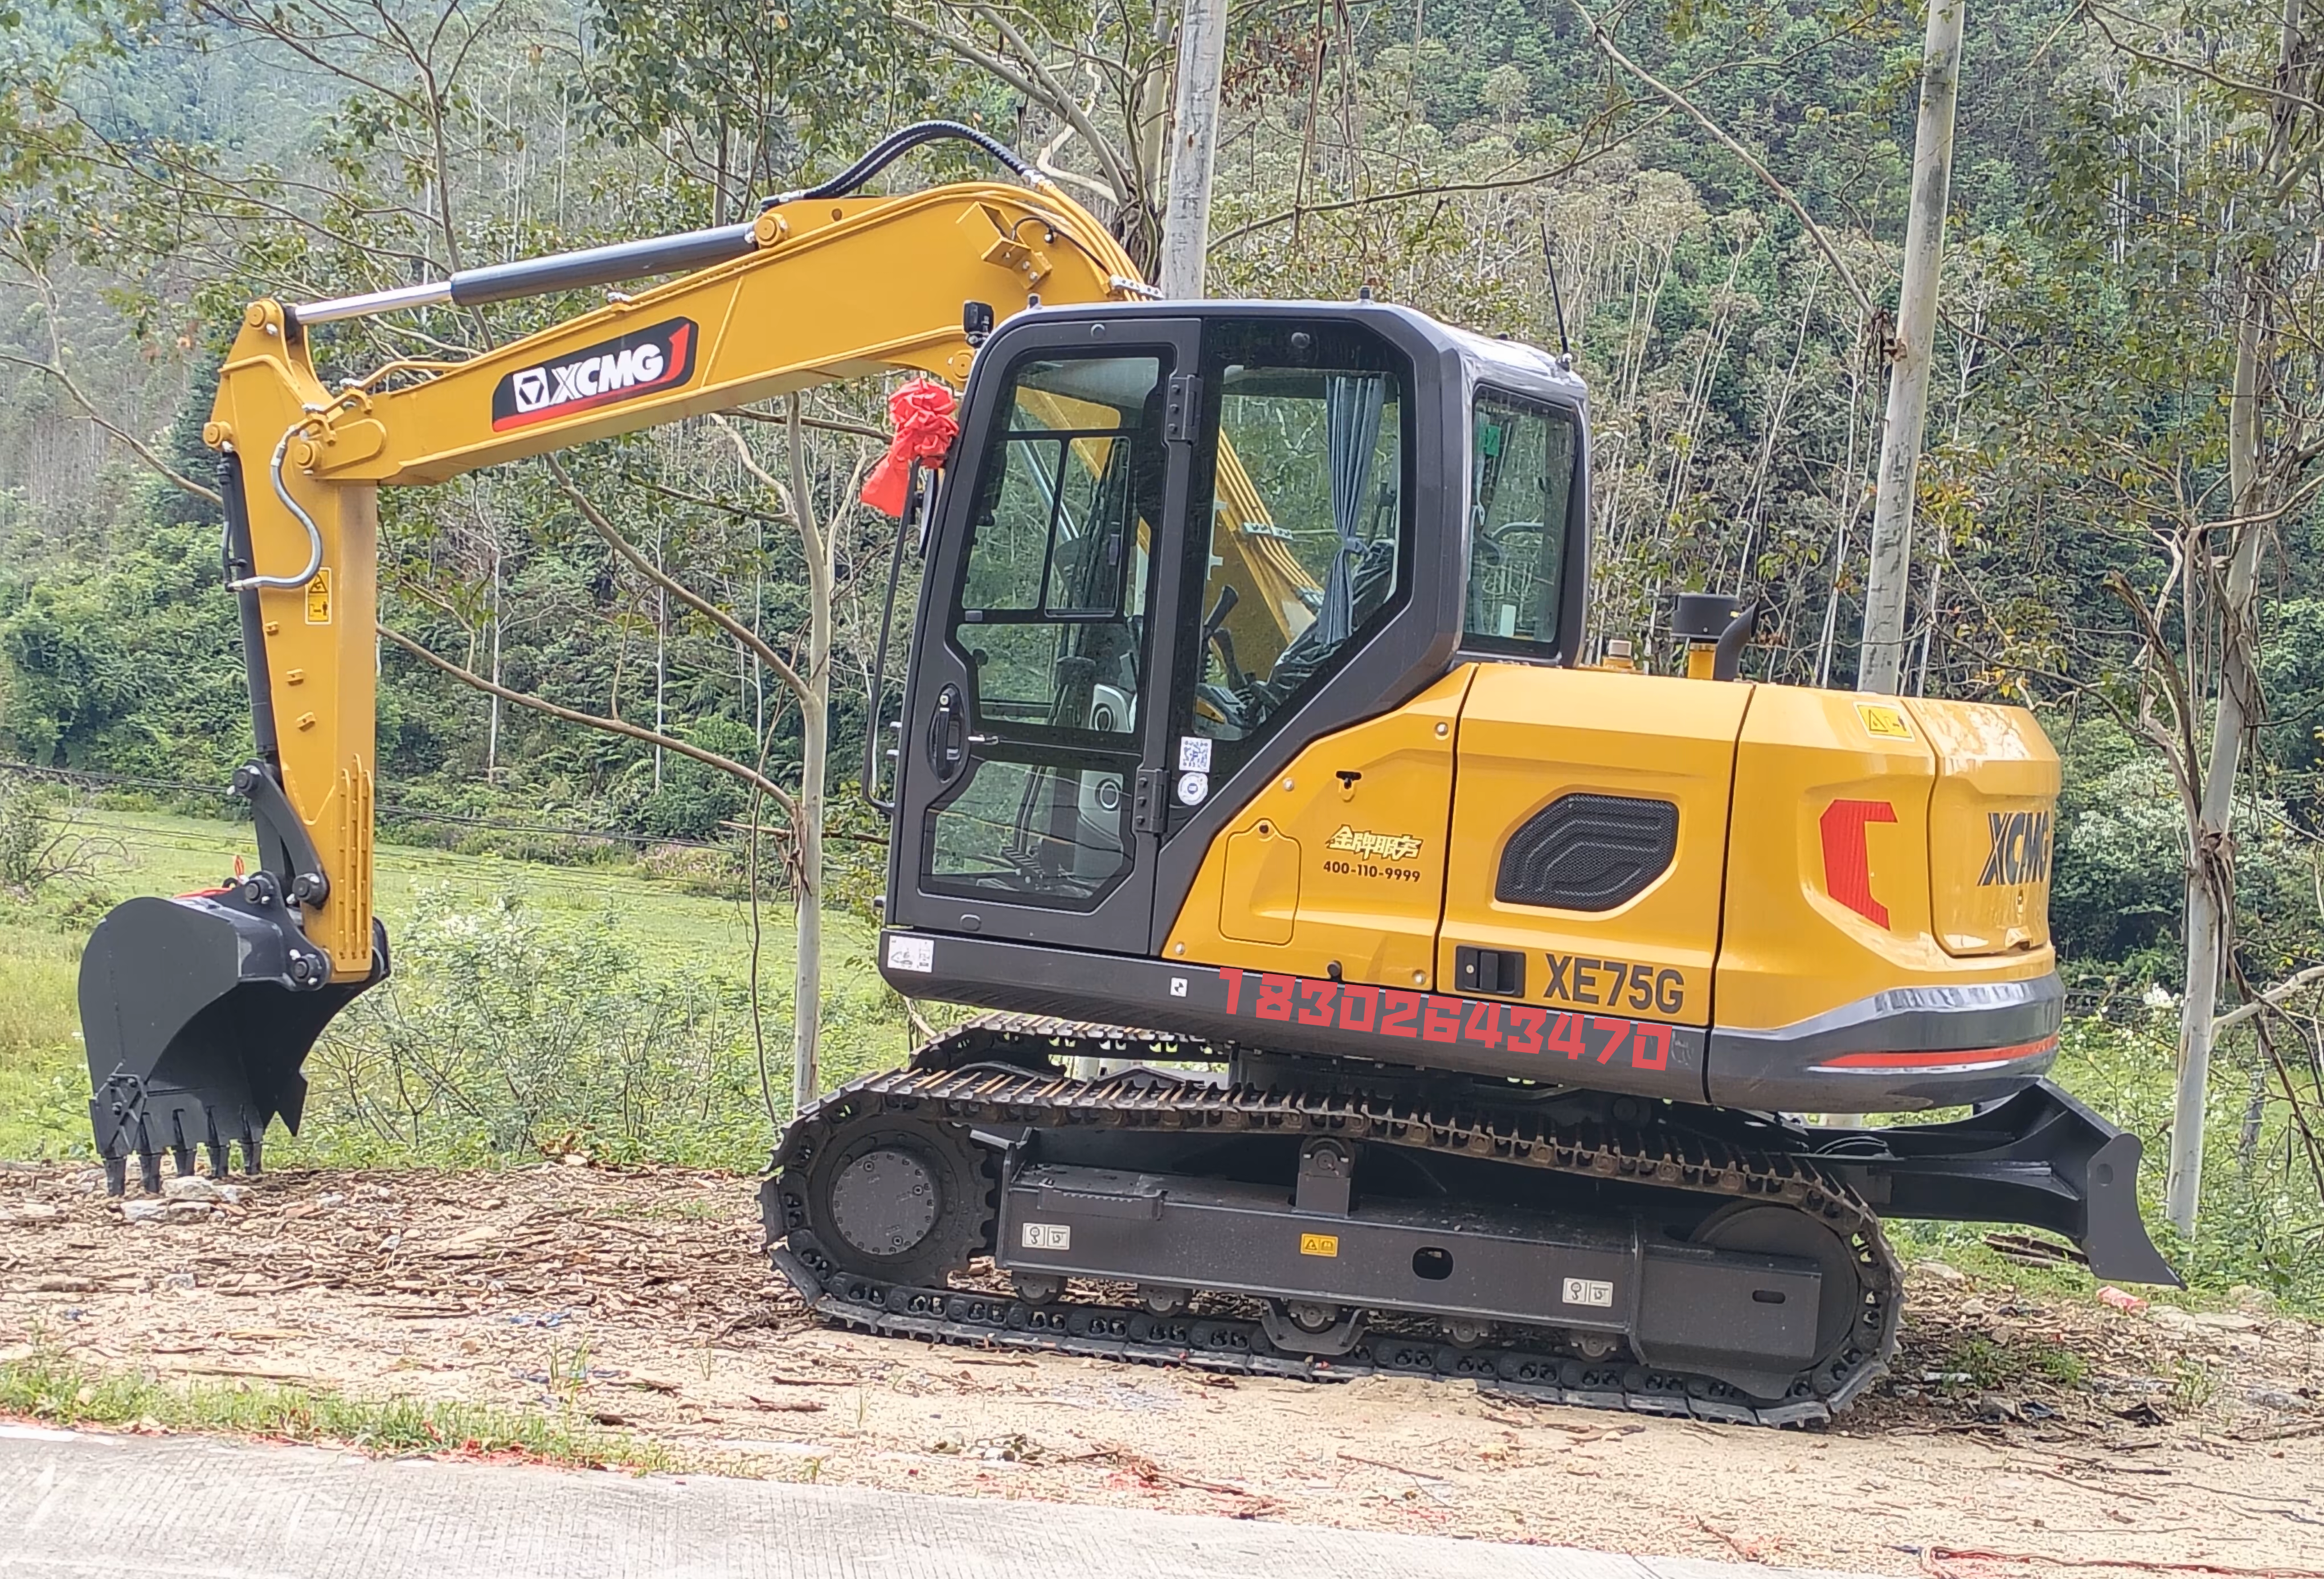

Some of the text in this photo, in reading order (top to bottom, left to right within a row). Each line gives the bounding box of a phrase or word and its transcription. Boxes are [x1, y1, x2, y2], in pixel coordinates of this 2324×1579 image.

[549, 343, 664, 405] XCMG
[1323, 861, 1420, 882] 400-110-9999
[1977, 811, 2049, 886] XCMG
[1543, 953, 1684, 1014] XE75G
